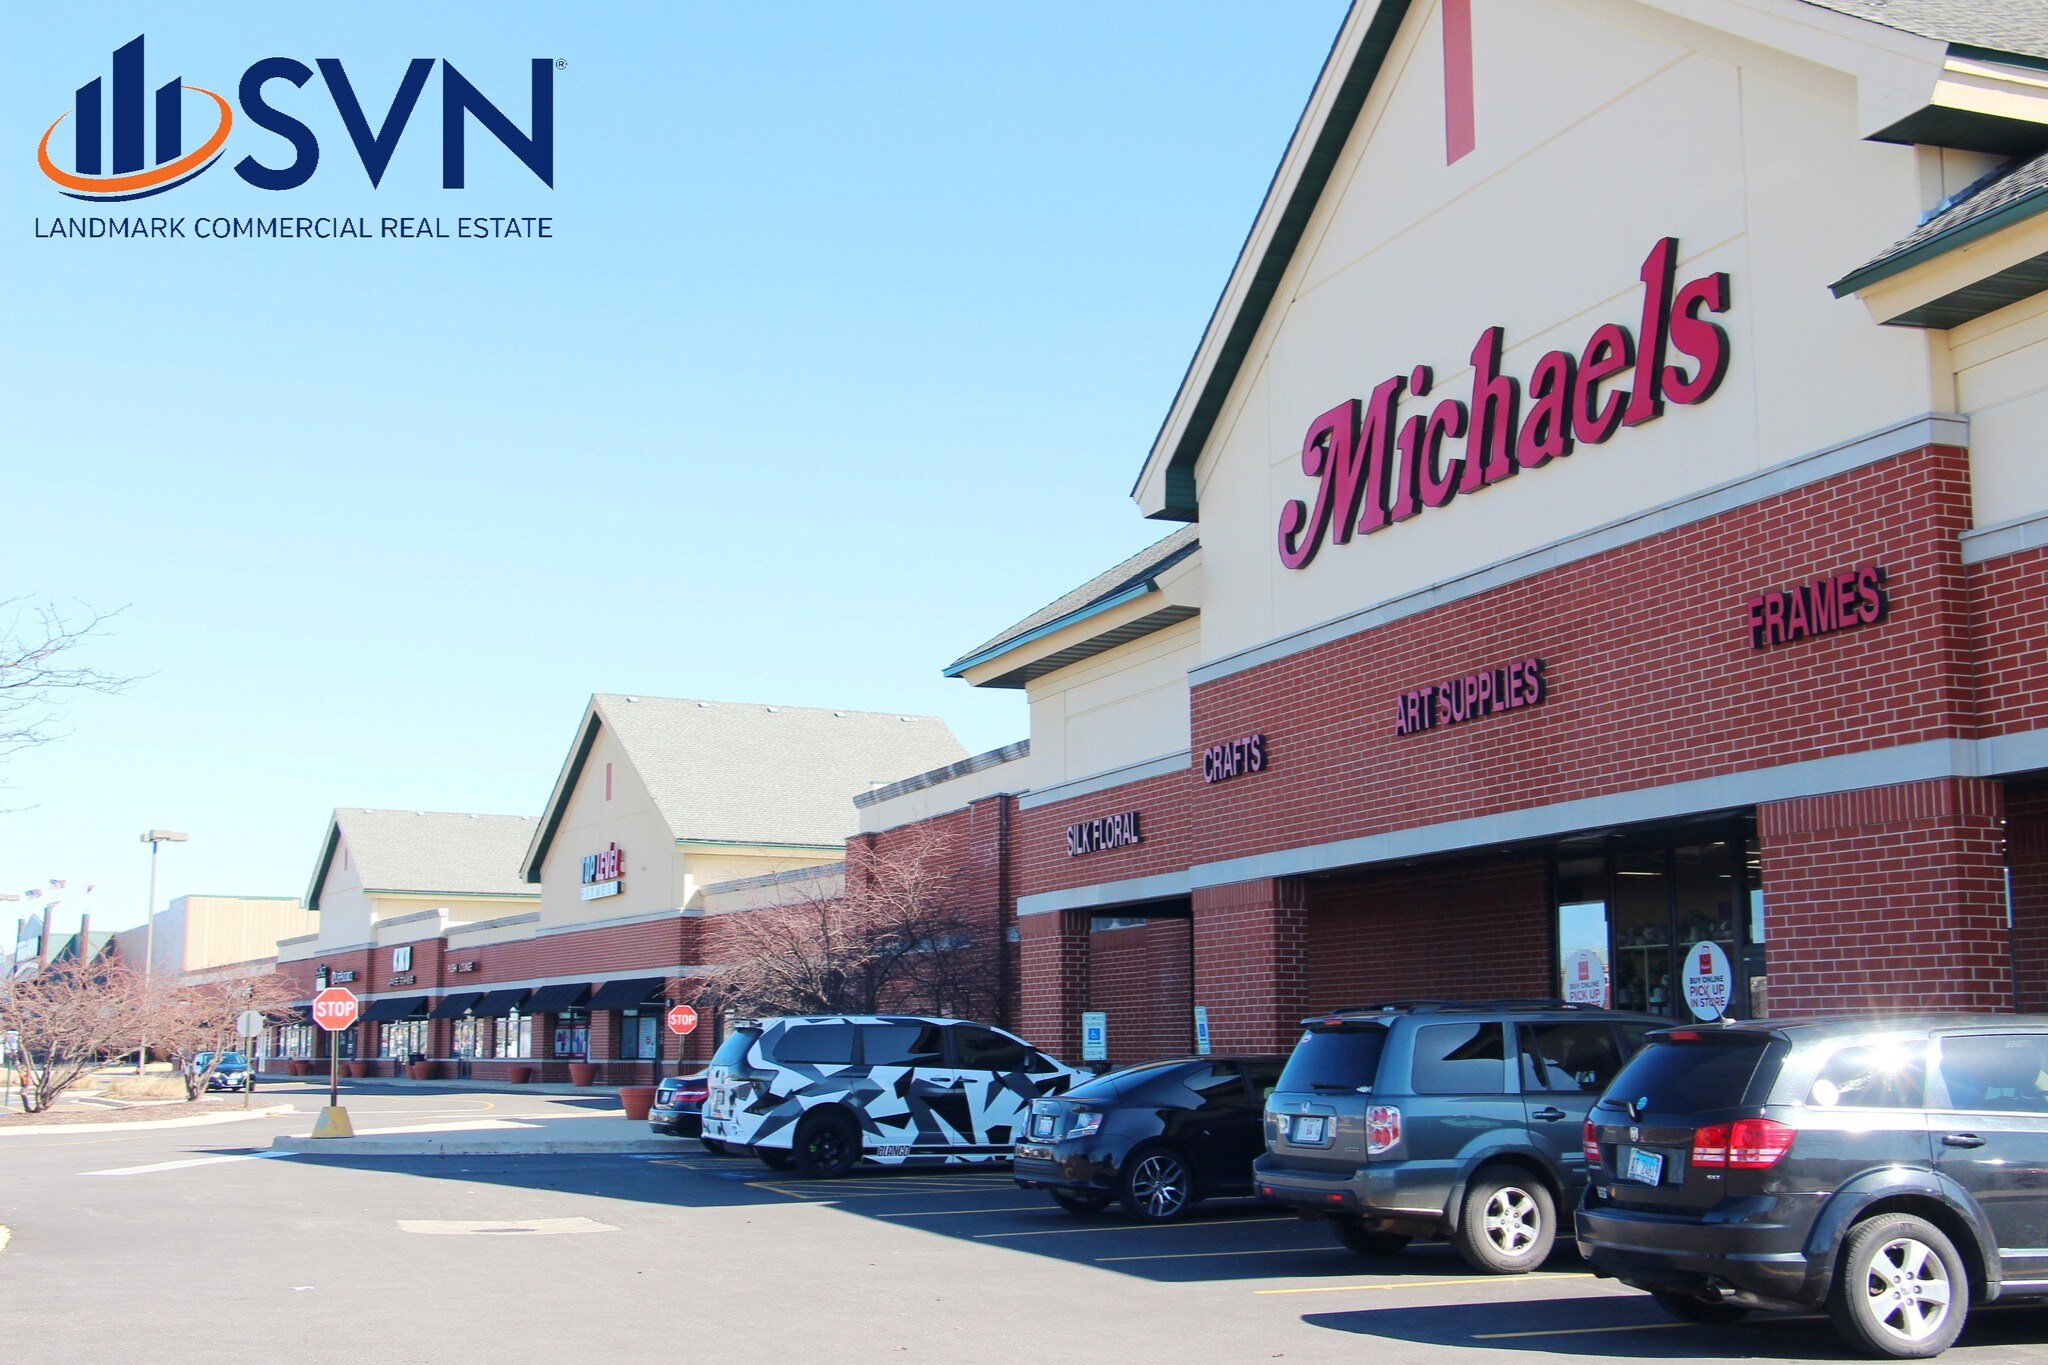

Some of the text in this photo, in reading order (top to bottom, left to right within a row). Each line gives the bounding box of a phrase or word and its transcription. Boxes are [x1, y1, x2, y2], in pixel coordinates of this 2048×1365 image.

[1278, 237, 1730, 570] Michaels
[1747, 566, 1887, 649] FRAMES
[1395, 658, 1545, 736] ART SUPPLIES
[1203, 734, 1266, 784] CRAFTS
[1066, 811, 1142, 857] SILK FLORAL
[596, 849, 621, 881] LEVEL
[1702, 975, 1724, 983] ONLINE
[1570, 988, 1600, 1000] PICK UP
[1690, 984, 1725, 996] PICK UP
[317, 1001, 355, 1017] STOP
[1691, 997, 1726, 1008] IN STORE
[670, 1013, 696, 1026] STOP
[877, 1146, 911, 1157] BLANCO
